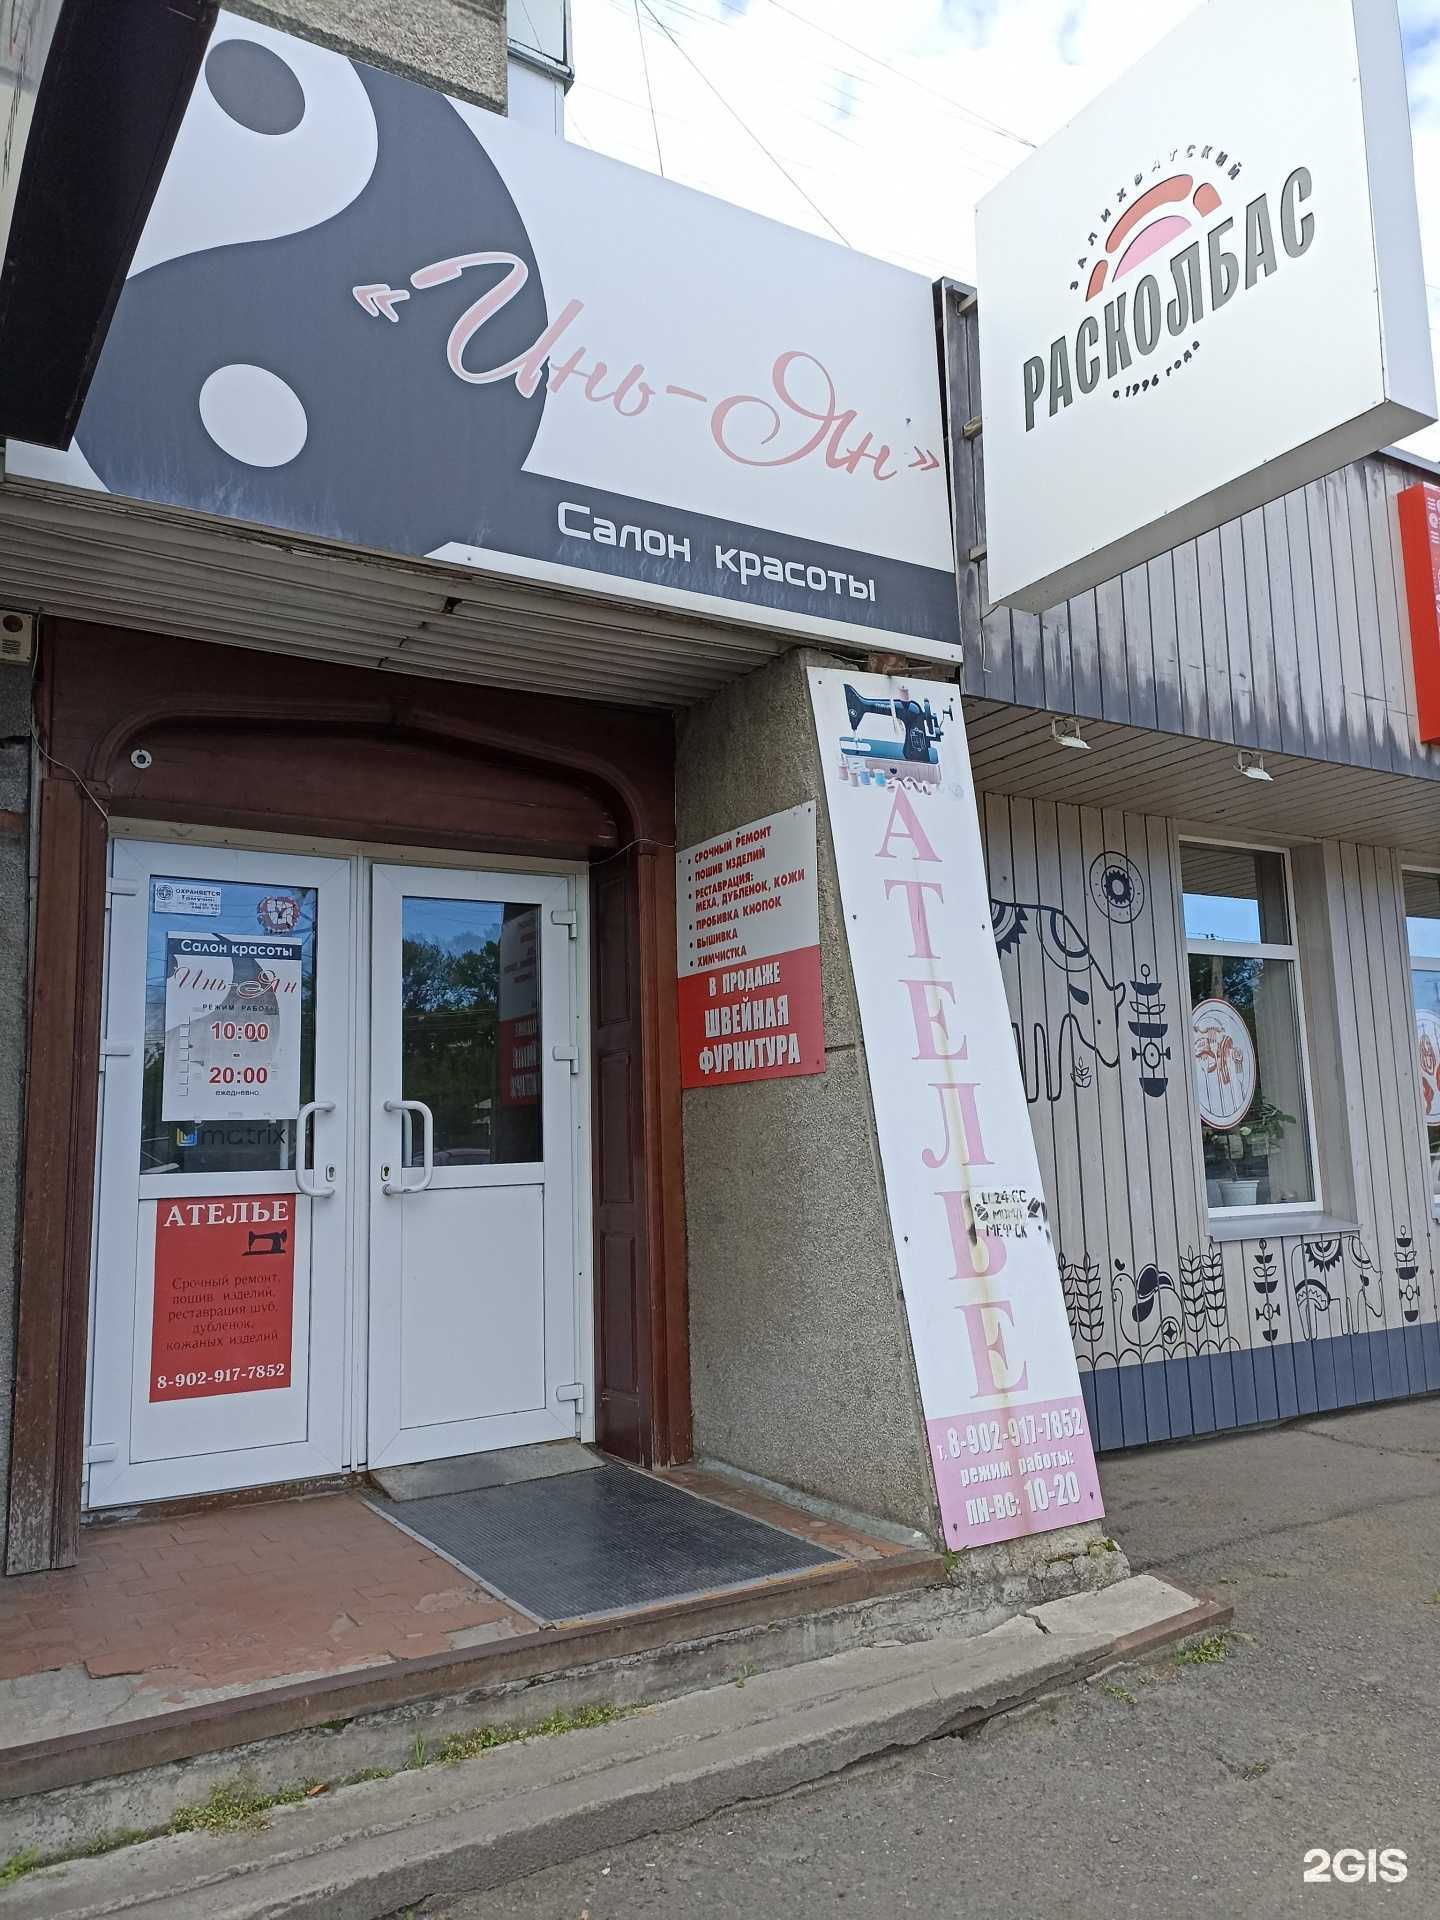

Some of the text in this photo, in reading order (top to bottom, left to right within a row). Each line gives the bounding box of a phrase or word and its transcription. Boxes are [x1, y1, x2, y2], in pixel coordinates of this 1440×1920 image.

[1023, 166, 1316, 432] РАСКОЛБАС
[1125, 373, 1160, 398] 1996
[556, 500, 877, 602] Салон красоты
[694, 825, 772, 864] СРОЧНЫЙ РЕМОНТ
[695, 845, 766, 881] ПОШИВ ИЗДЕЛИЙ
[695, 871, 754, 900] РЕСТАВРАЦИЯ:
[695, 896, 720, 912] МЕХА,
[773, 868, 805, 888] КОЖИ
[695, 895, 782, 931] ПРОБИВКА КНОПОК
[181, 939, 293, 956] Салон красоты
[696, 927, 738, 949] ВЫШИВКА
[697, 944, 748, 968] ХИМЧИСТКА
[708, 961, 781, 997] В ПРОДАЖЕ
[202, 1003, 235, 1011] РЕЖИМ
[704, 994, 790, 1039] ШВЕЙНАЯ
[211, 1022, 269, 1040] 10:00
[698, 1032, 801, 1075] ФУРНИТУРА
[208, 1066, 268, 1084] 20:00
[215, 1089, 259, 1097] ежедневно
[202, 1124, 287, 1145] matrix
[163, 1200, 289, 1227] АТЕЛЬЕ
[171, 1273, 229, 1292] Срочный
[172, 1293, 214, 1305] пошив
[168, 1304, 247, 1322] реставрация
[166, 1330, 279, 1352] кожаных изделий
[157, 1363, 286, 1389] 8-902-917-7852
[947, 1407, 1084, 1459] 8-902-917-7852
[960, 1449, 1076, 1487] режим работы:
[1023, 1470, 1082, 1513] 10-20
